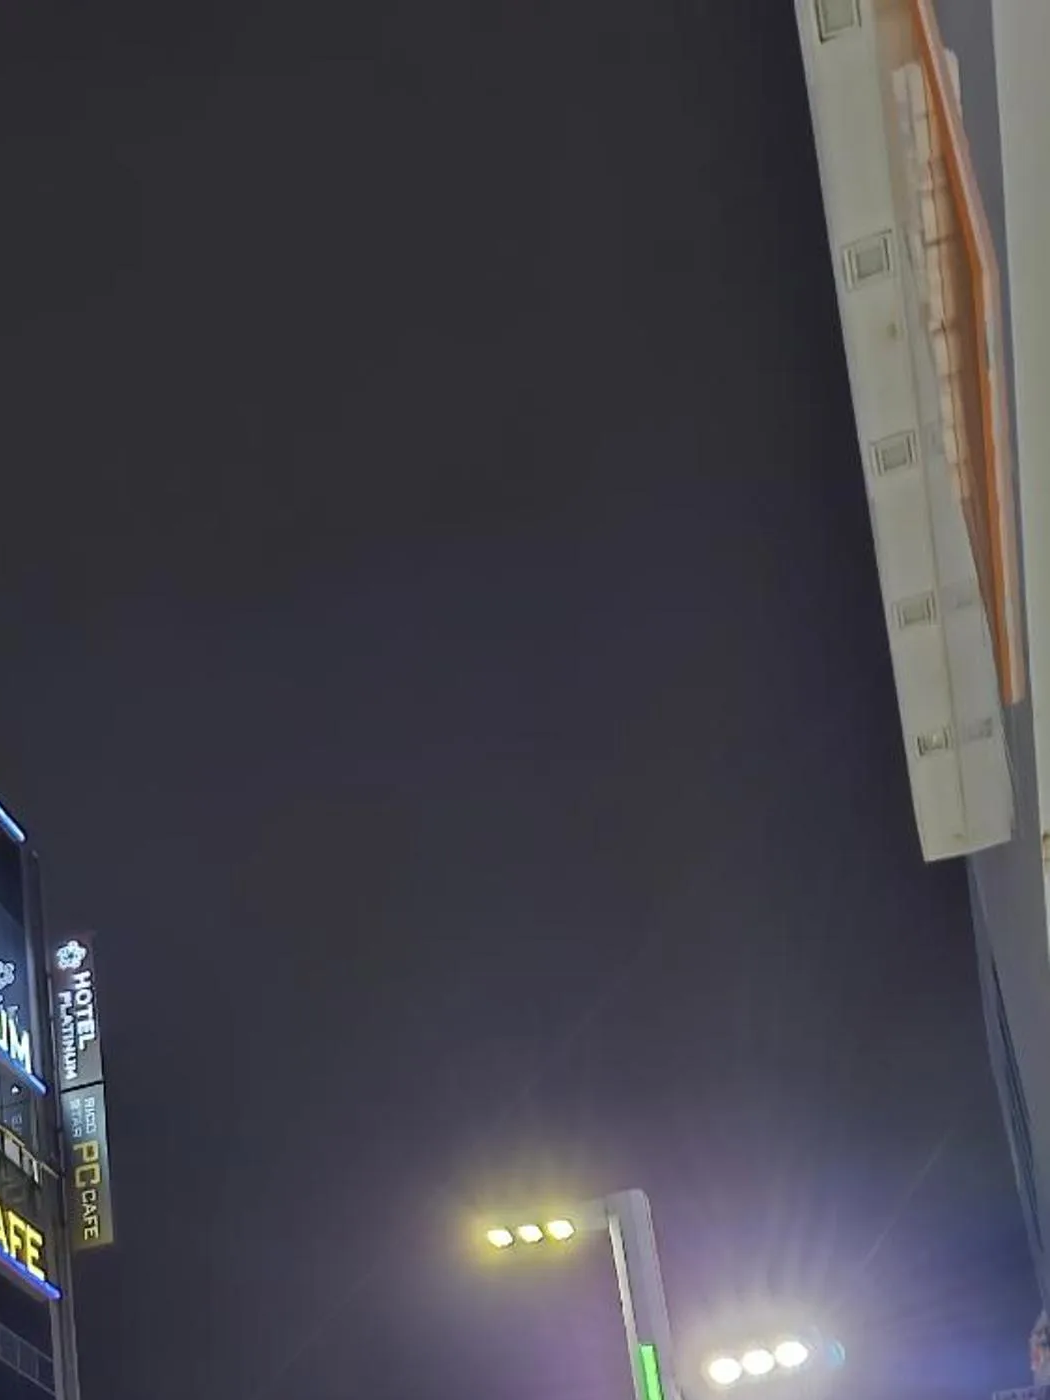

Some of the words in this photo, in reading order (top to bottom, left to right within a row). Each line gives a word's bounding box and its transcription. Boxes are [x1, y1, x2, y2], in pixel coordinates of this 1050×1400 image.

[58, 991, 78, 1080] PLATINUM
[70, 970, 96, 1050] HOTEL
[73, 1140, 101, 1188] PC
[81, 1188, 100, 1241] CAFE
